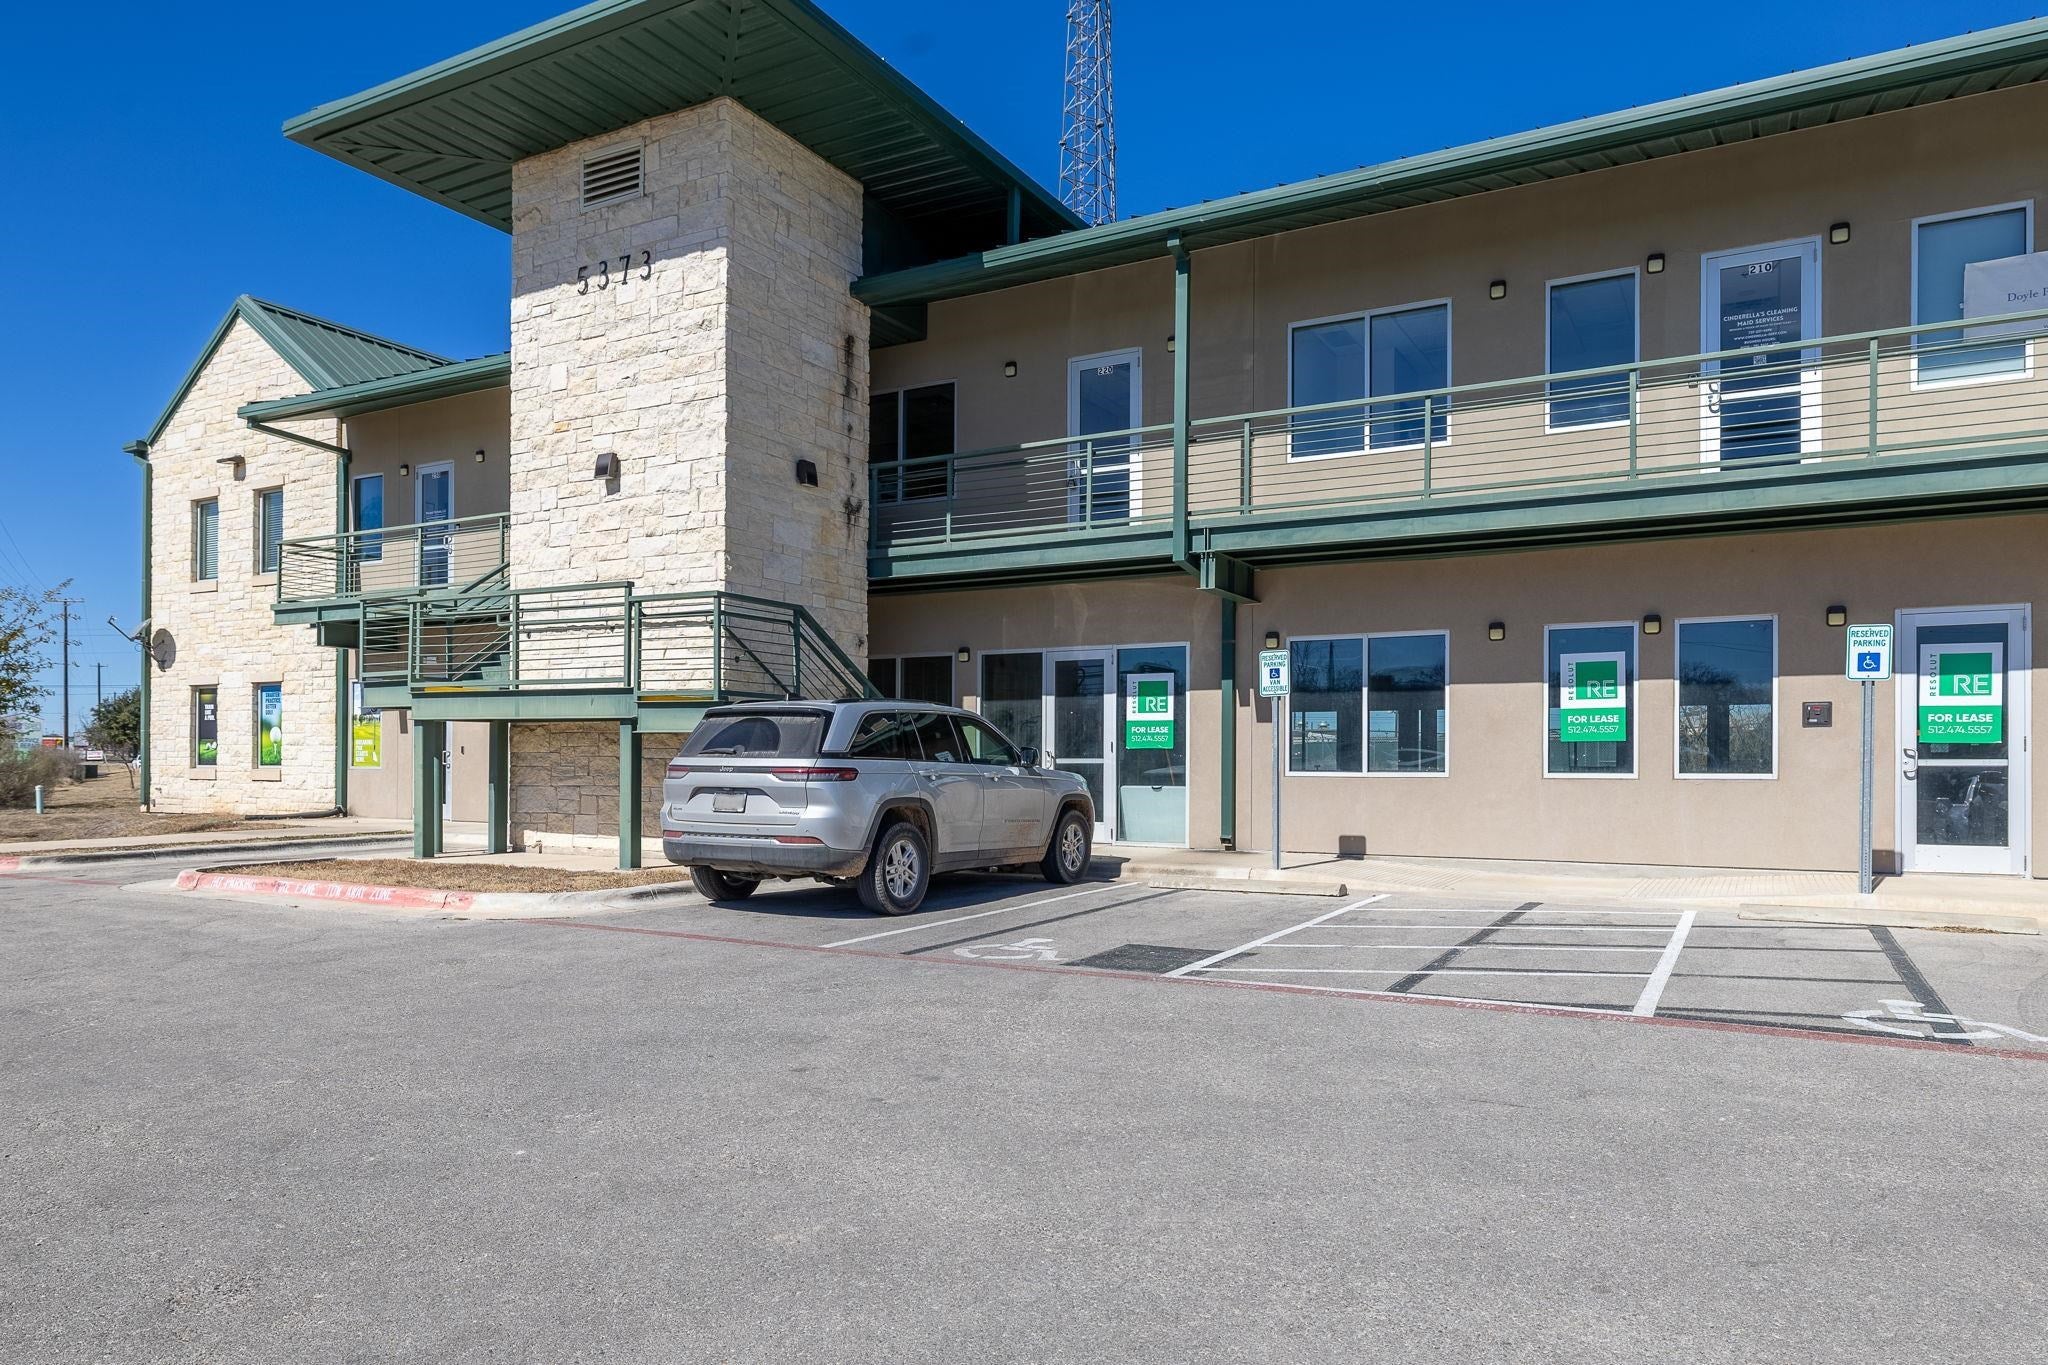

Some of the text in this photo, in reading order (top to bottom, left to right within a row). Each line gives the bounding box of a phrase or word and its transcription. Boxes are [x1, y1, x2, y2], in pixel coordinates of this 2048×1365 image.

[577, 250, 652, 296] 5373
[1749, 262, 1772, 275] 210
[2007, 289, 2039, 302] Doyle
[1723, 306, 1798, 322] CINDERELLA'S CLEANING
[1737, 319, 1754, 327] MAID
[1755, 315, 1784, 325] SERVICES
[1097, 365, 1113, 375] 220
[1851, 630, 1889, 638] RESERVED
[1853, 639, 1886, 647] PARKING
[1929, 653, 1937, 696] RESOLUT
[1586, 680, 1616, 698] RE
[1953, 674, 1990, 694] RE
[1145, 696, 1167, 712] RE
[1567, 714, 1620, 723] FOR LEASE
[1927, 713, 1994, 723] FOR LEASE
[1567, 725, 1619, 734] 512.474.5557
[1928, 725, 1993, 734] 512.474.5557
[720, 765, 734, 773] Jeep
[295, 882, 317, 896] LANE
[369, 887, 394, 901] ZONE
